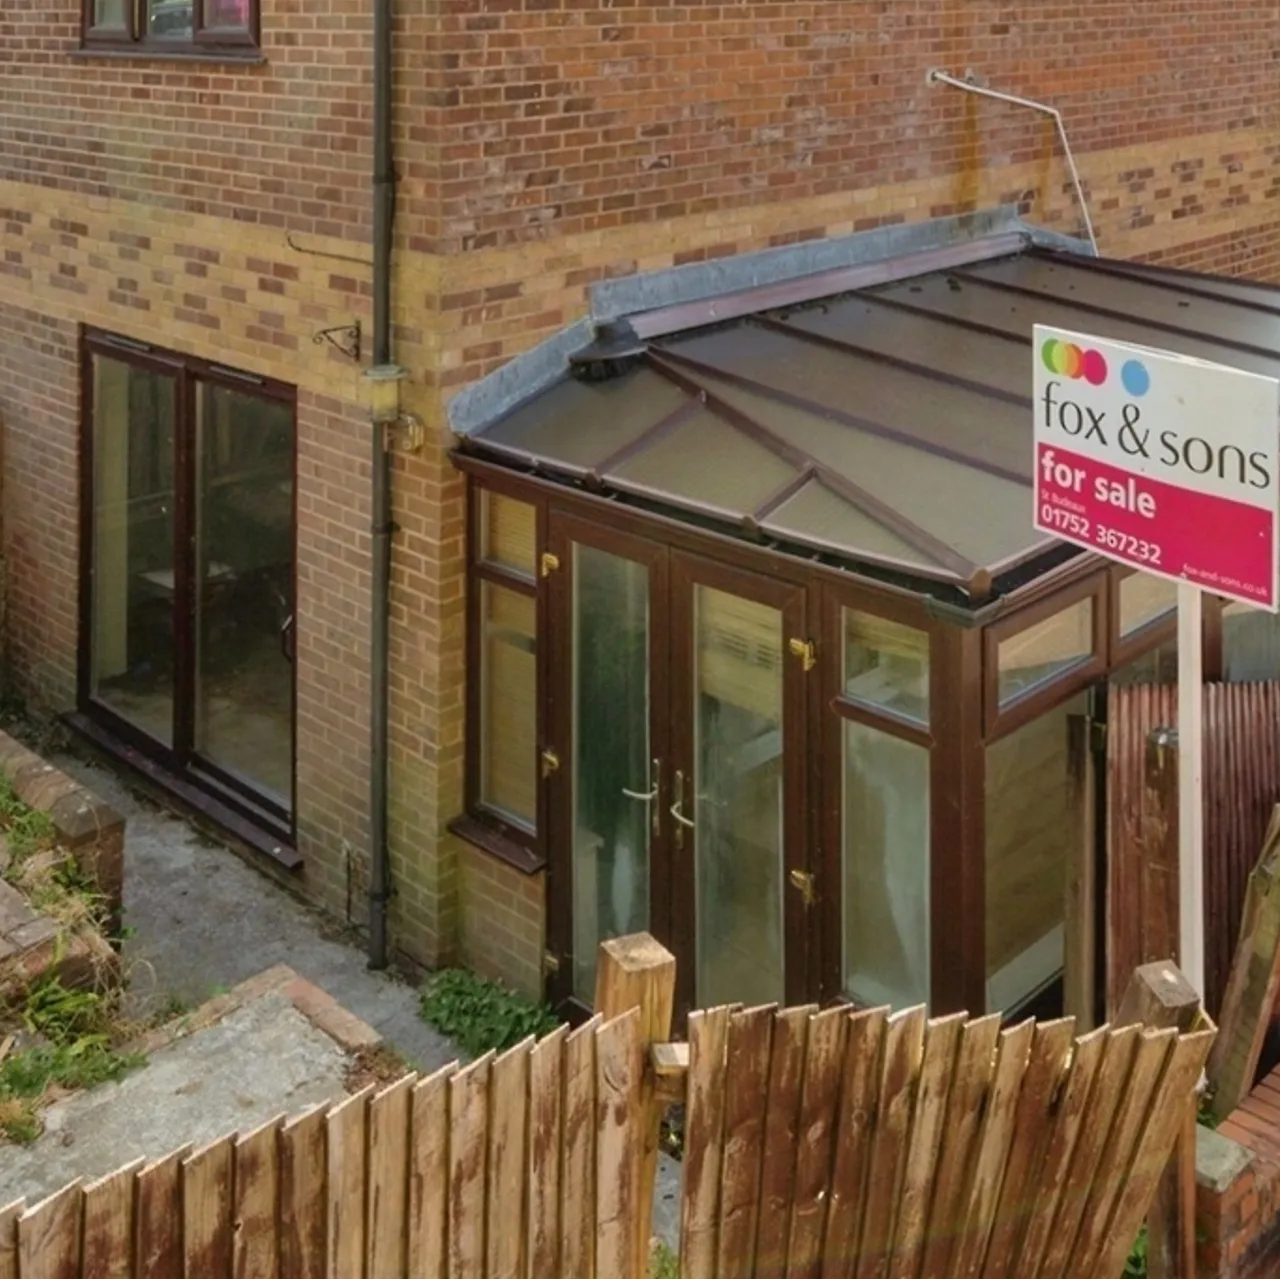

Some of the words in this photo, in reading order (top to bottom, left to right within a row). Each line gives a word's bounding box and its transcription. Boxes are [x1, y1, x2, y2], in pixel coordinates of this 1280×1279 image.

[1041, 381, 1108, 446] fox
[1118, 404, 1150, 459] &
[1160, 430, 1270, 489] sons
[1041, 450, 1086, 493] for
[1094, 477, 1156, 519] sale
[1042, 504, 1090, 538] 01752
[1096, 523, 1161, 565] 367232
